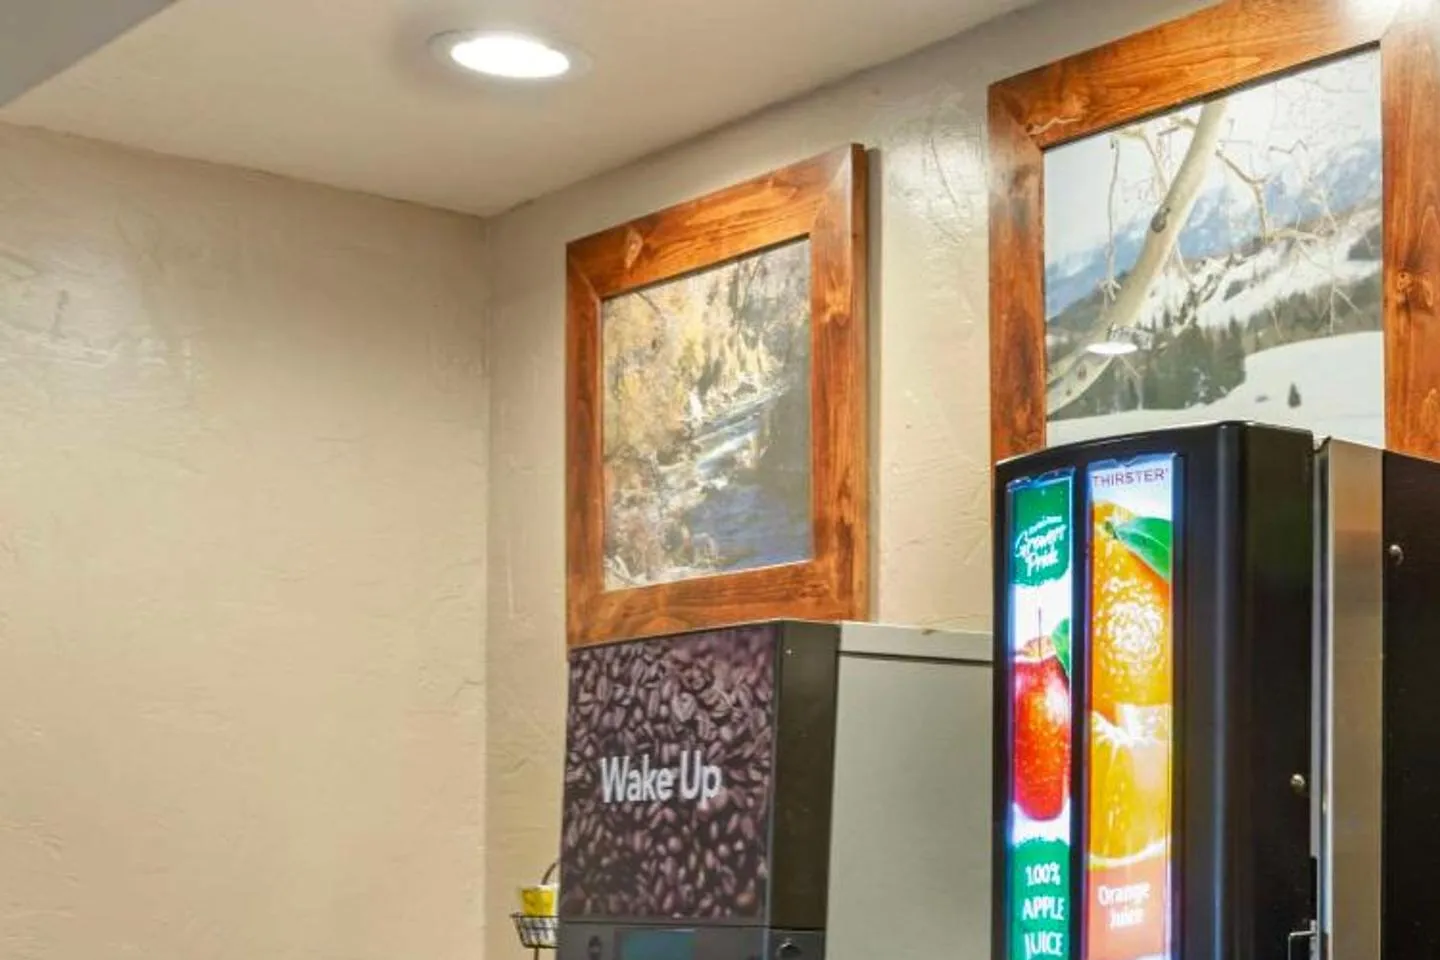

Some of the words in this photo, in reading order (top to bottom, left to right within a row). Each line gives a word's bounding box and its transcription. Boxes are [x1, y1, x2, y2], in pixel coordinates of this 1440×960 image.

[600, 753, 674, 803] Wake
[680, 749, 722, 810] Up
[1024, 860, 1061, 887] 100%
[1022, 895, 1065, 921] APPLE
[1024, 930, 1063, 960] JUICE
